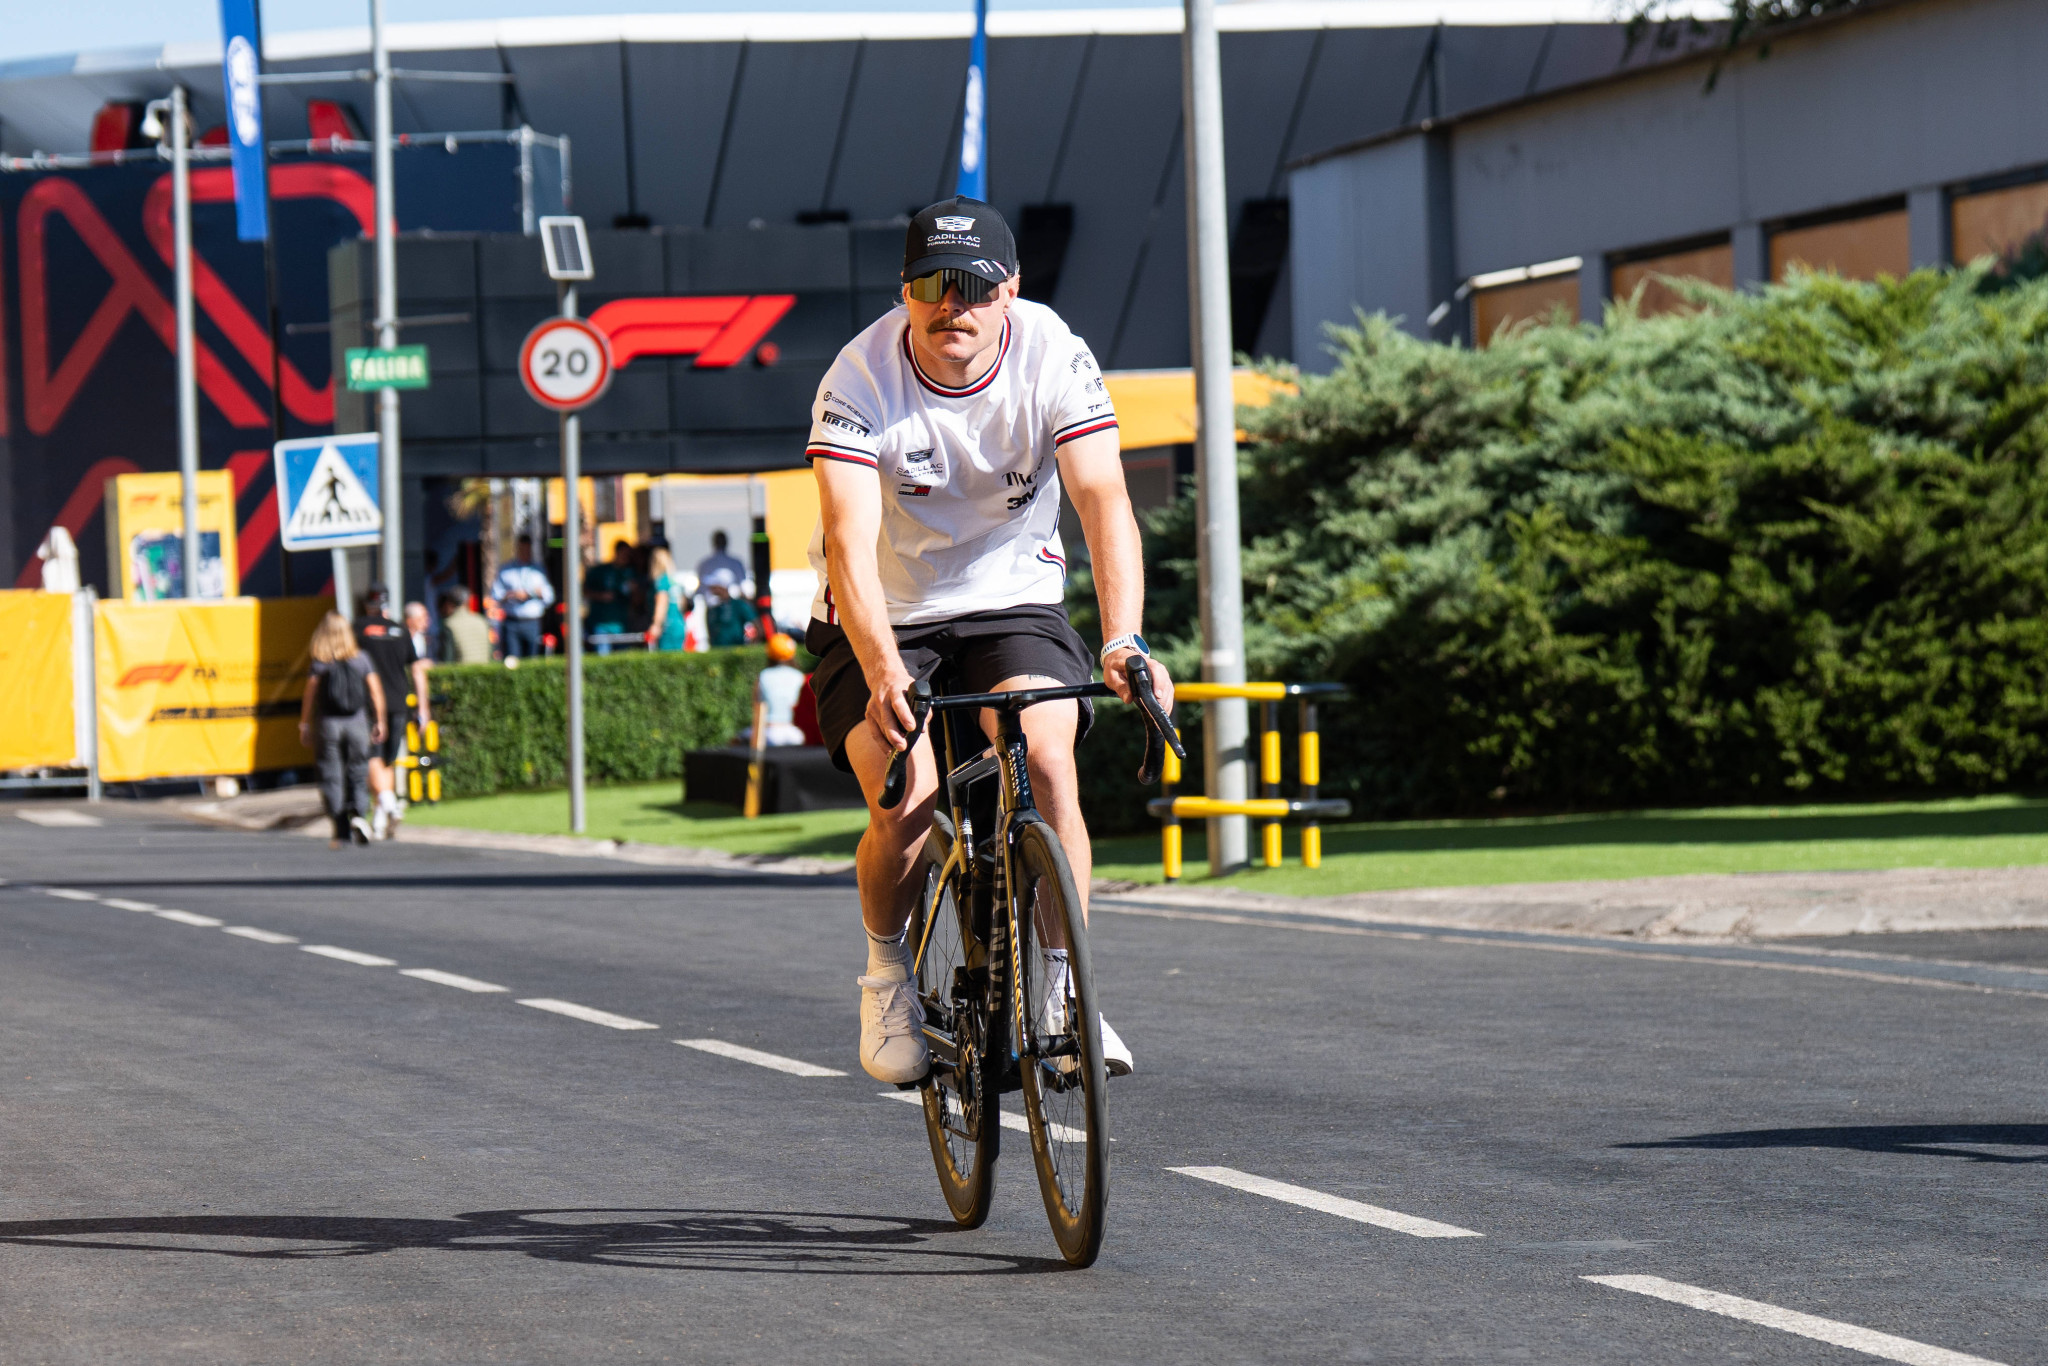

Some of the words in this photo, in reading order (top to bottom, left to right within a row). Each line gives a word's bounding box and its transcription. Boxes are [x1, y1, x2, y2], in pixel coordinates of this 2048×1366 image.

[927, 233, 980, 243] CADILLAC
[962, 240, 980, 248] TEAM
[541, 348, 589, 377] 20
[831, 396, 847, 407] CORE
[822, 410, 870, 437] PIRELLI
[896, 463, 943, 474] CADILLAC
[1007, 483, 1037, 510] 3M
